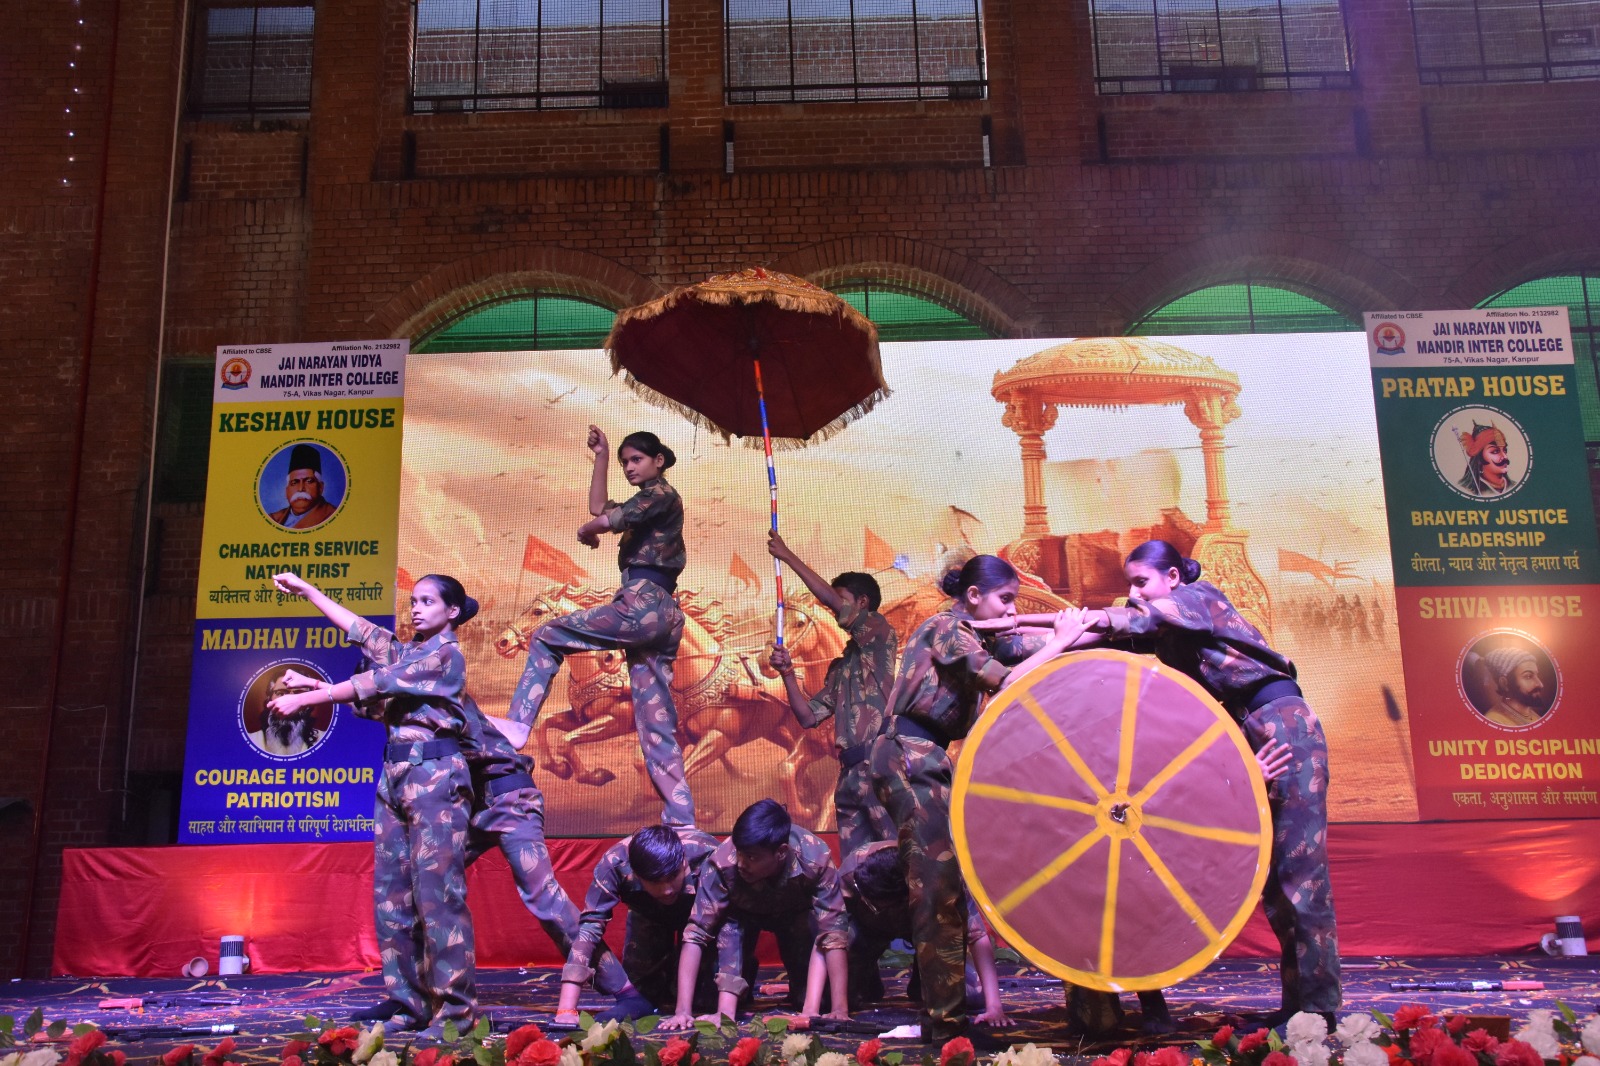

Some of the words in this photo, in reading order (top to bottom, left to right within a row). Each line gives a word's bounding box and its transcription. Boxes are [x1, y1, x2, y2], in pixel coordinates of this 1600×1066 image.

[1432, 322, 1450, 336] JAI
[1453, 321, 1506, 336] NARAYAN
[1507, 320, 1543, 335] VIDYA
[1417, 340, 1464, 354] MANDIR
[1467, 339, 1504, 354] INTER
[1507, 338, 1563, 352] COLLEGE
[278, 357, 295, 371] JAI
[298, 355, 348, 370] NARAYAN
[350, 354, 382, 368] VIDYA
[1443, 356, 1463, 364] 75-A,
[1486, 356, 1510, 364] Nagar,
[1512, 355, 1539, 364] Kanpur
[260, 374, 305, 388] MANDIR
[309, 372, 343, 387] INTER
[346, 371, 399, 386] COLLEGE
[1381, 376, 1476, 398] PRATAP
[1481, 375, 1566, 397] HOUSE
[323, 389, 346, 398] Nagar,
[348, 388, 374, 396] Kanpur
[219, 410, 311, 433] KESHAV
[316, 408, 395, 430] HOUSE
[1411, 510, 1490, 526] BRAVERY
[1495, 509, 1569, 525] JUSTICE
[1438, 531, 1546, 548] LEADERSHIP
[219, 542, 309, 559] CHARACTER
[314, 540, 379, 557] SERVICE
[245, 563, 302, 580] NATION
[306, 563, 350, 578] FIRST
[1411, 552, 1446, 575] वीरता,
[1448, 557, 1474, 571] न्याय
[1476, 551, 1497, 571] और
[1498, 551, 1528, 575] नेतृत्व
[1530, 556, 1561, 573] हमारा
[1562, 550, 1580, 570] गर्व
[254, 583, 274, 603] और
[346, 582, 383, 601] सर्वोपरि
[1419, 597, 1492, 619] SHIVA
[1497, 595, 1583, 618] HOUSE
[201, 628, 300, 650] MADHAV
[1429, 739, 1488, 757] UNITY
[195, 768, 286, 786] COURAGE
[292, 767, 374, 784] HONOUR
[1460, 762, 1583, 780] DEDICATION
[226, 791, 340, 808] PATRIOTISM
[1452, 791, 1486, 807] एकता,
[1490, 791, 1538, 811] अनुशासन
[1541, 786, 1560, 804] और
[1562, 786, 1598, 804] समर्पण
[188, 820, 215, 836] साहस
[218, 814, 236, 833] और
[238, 815, 284, 833] स्वाभिमान
[287, 815, 296, 832] से
[298, 814, 330, 838] परिपूर्ण
[332, 814, 375, 832] देशभक्ति
